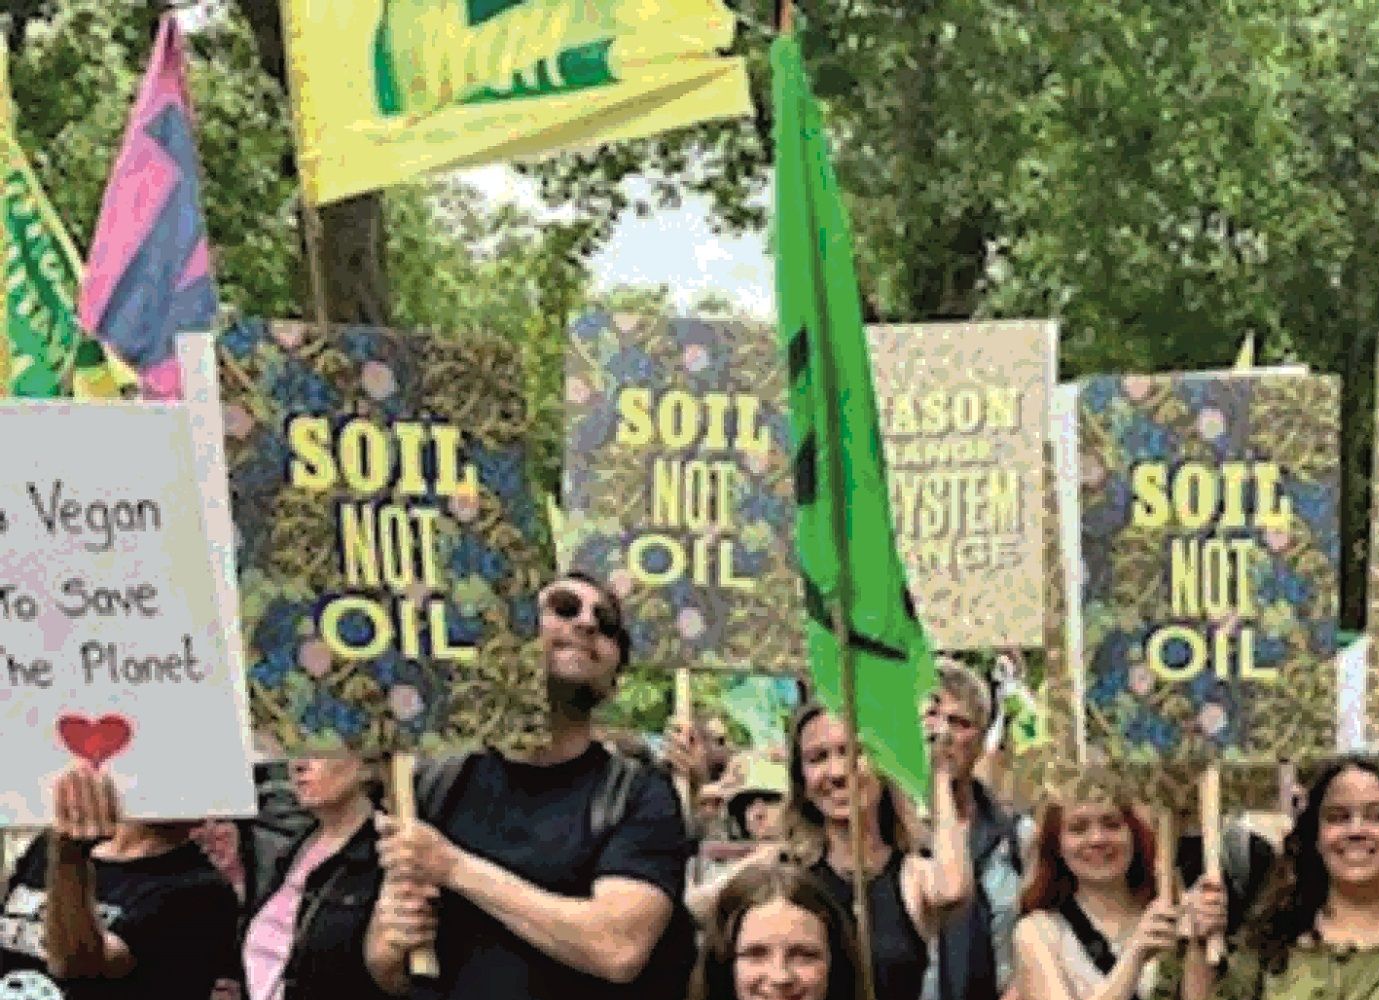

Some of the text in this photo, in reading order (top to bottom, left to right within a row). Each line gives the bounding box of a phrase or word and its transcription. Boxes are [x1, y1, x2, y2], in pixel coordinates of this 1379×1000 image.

[616, 387, 769, 451] SOIL
[882, 385, 1017, 434] ASON
[288, 416, 478, 495] SOIL
[26, 478, 162, 552] Vegan
[652, 459, 737, 529] NOT
[891, 470, 1018, 535] YSTEM
[1132, 462, 1291, 528] SOIL
[341, 504, 441, 590] NOT
[627, 535, 754, 588] OIL
[1170, 539, 1254, 617] NOT
[55, 578, 160, 620] Save
[321, 597, 478, 660] OIL
[0, 633, 205, 688] he Planet
[1145, 625, 1280, 680] OIL
